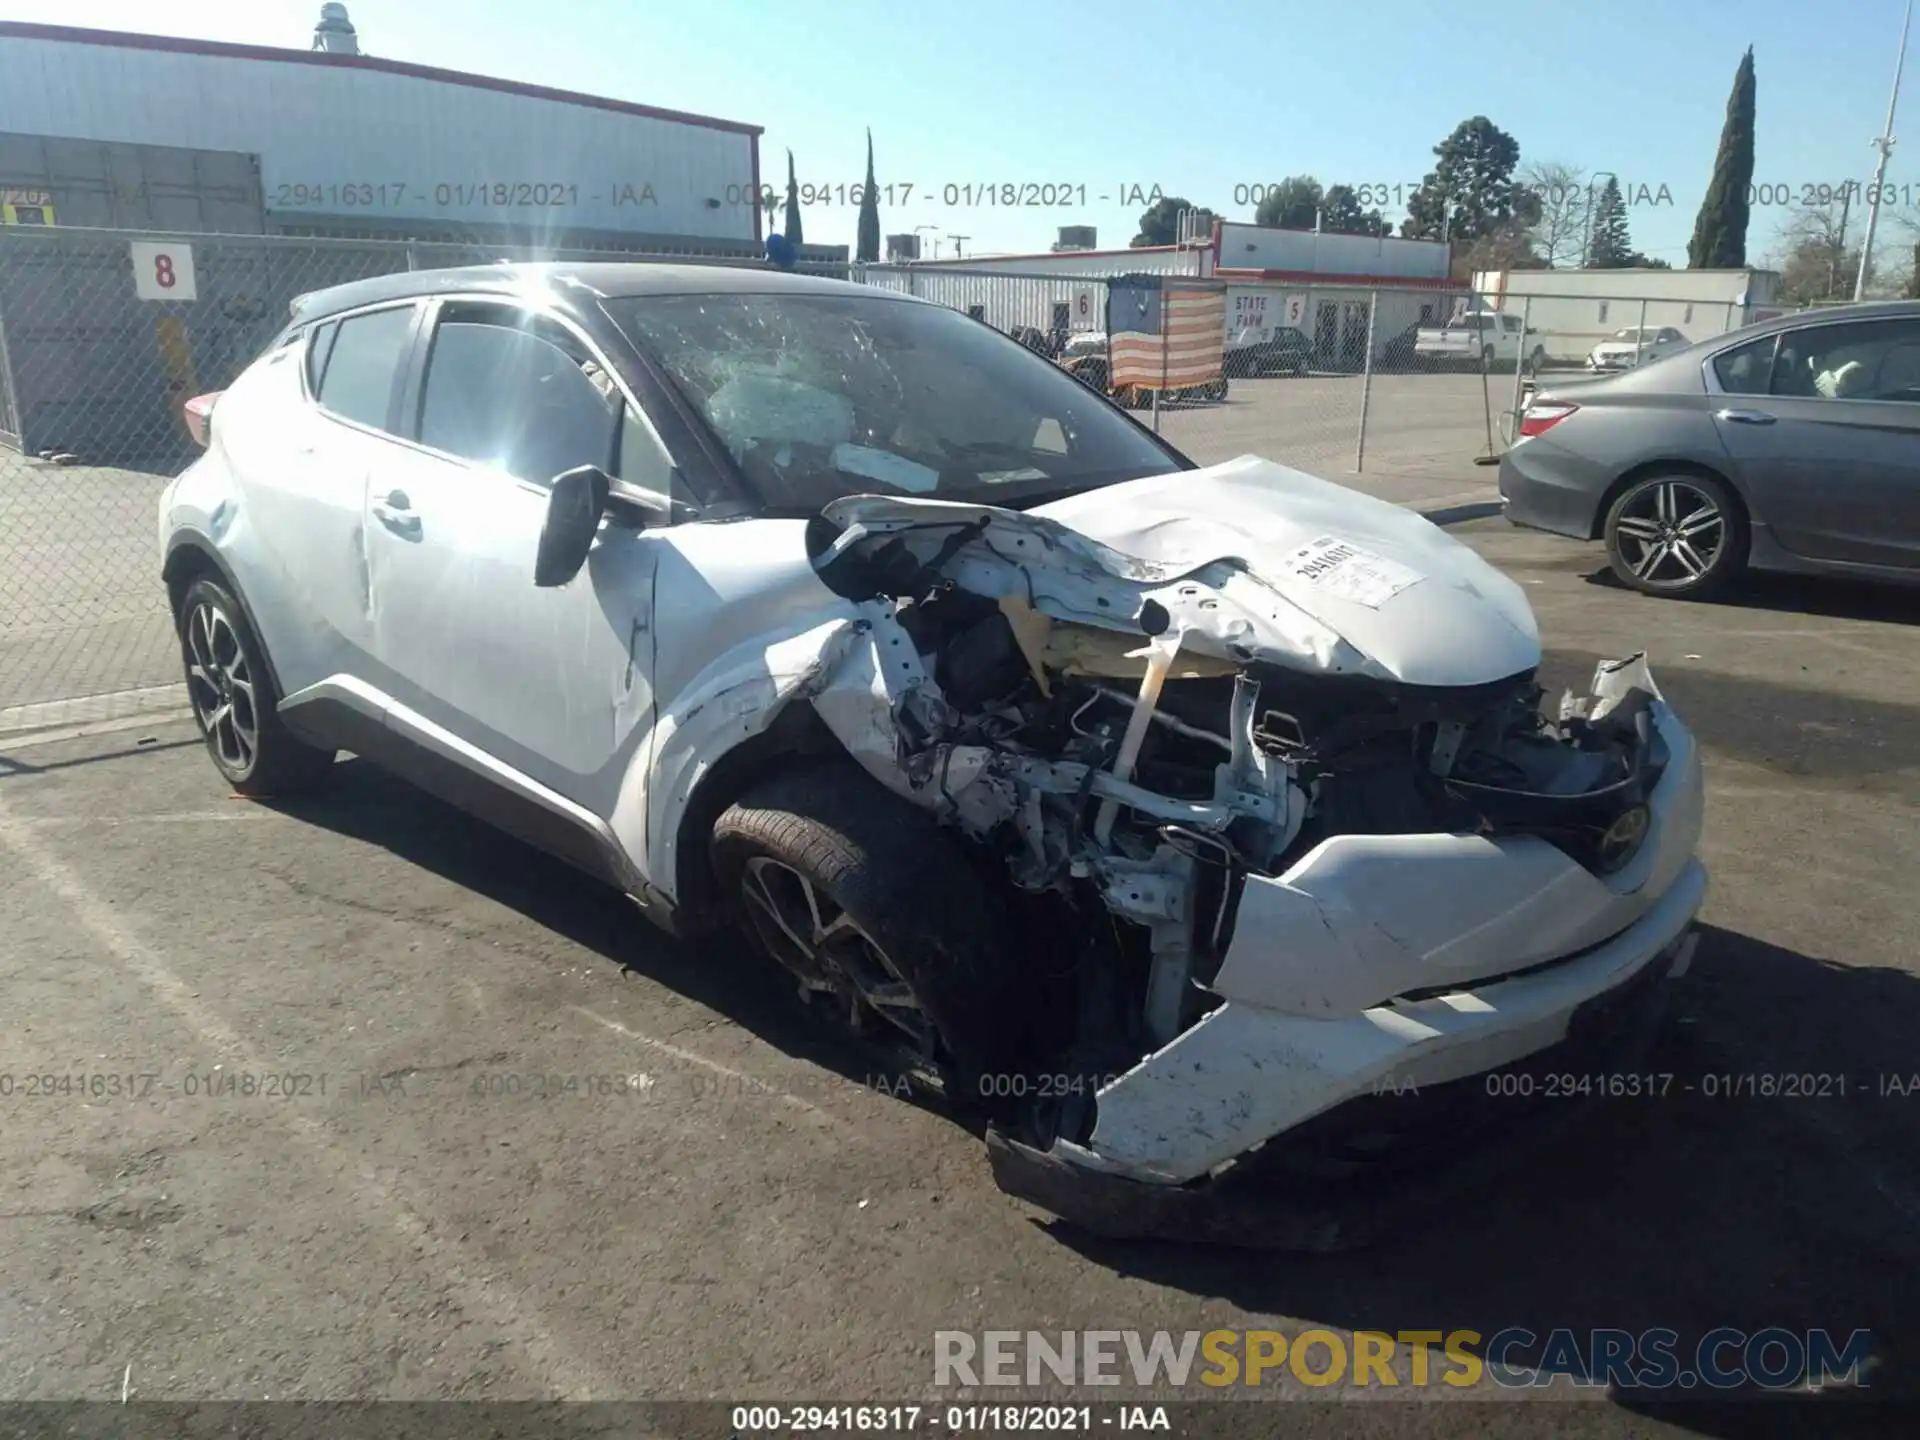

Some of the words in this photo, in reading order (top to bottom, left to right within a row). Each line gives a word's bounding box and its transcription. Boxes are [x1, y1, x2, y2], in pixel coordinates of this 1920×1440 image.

[154, 253, 176, 289] 8
[1079, 294, 1089, 315] 6
[1235, 296, 1268, 311] STATE
[1290, 301, 1299, 320] 5
[1235, 313, 1263, 327] FARM
